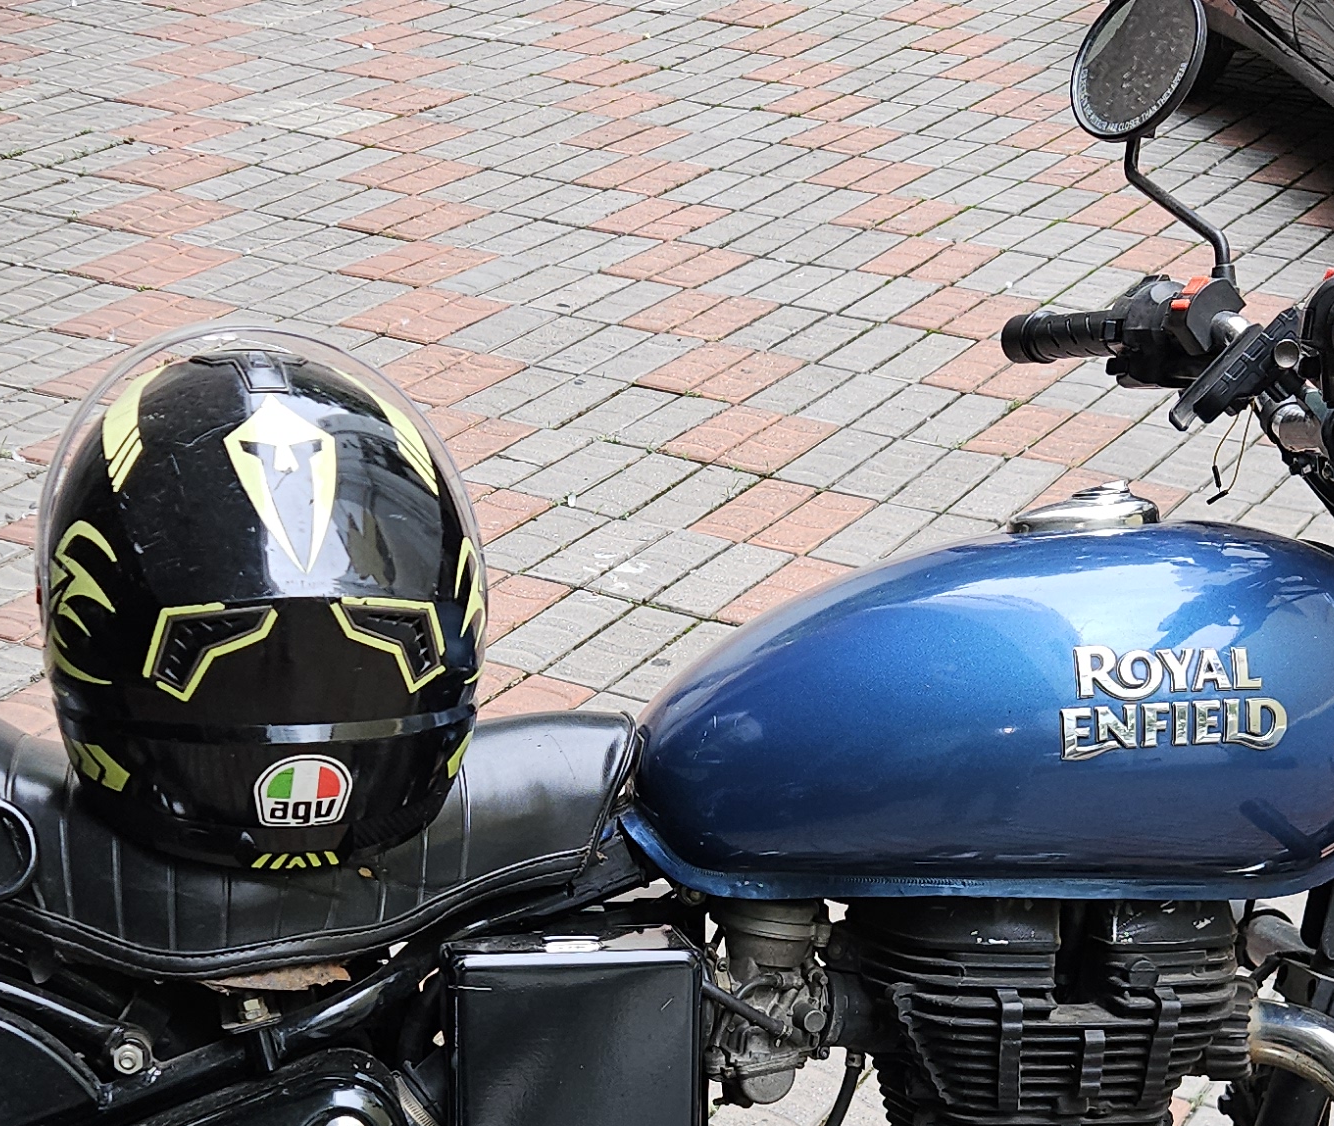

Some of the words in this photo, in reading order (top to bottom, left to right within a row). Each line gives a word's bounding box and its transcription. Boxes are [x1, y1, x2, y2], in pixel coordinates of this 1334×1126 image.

[1118, 117, 1141, 132] CLOSER
[1073, 645, 1262, 701] ROYAL
[1059, 697, 1288, 761] ENFIELD
[269, 798, 337, 824] agv
